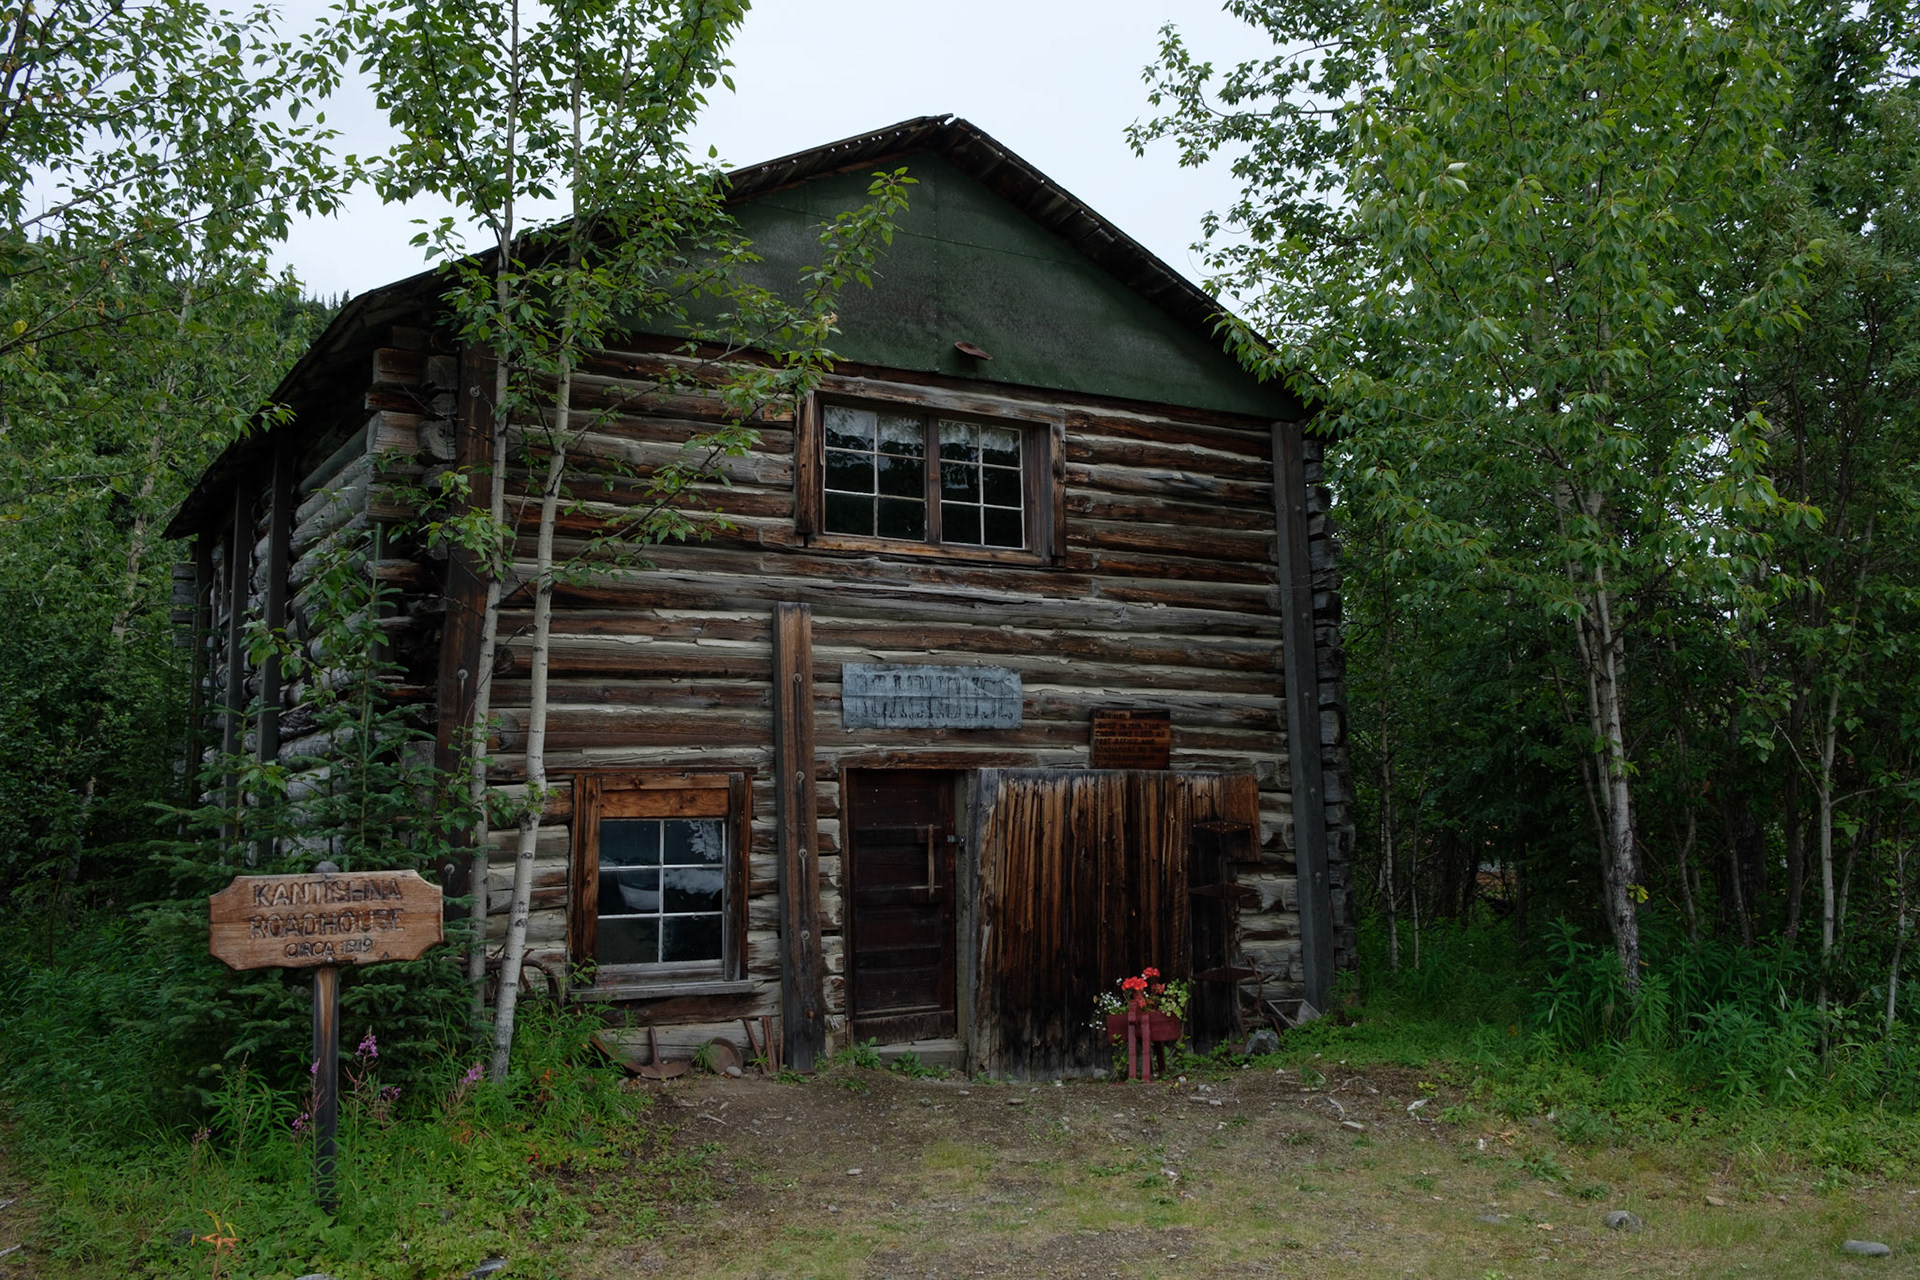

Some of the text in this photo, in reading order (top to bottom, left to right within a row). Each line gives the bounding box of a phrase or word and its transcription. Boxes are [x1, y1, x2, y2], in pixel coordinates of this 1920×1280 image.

[253, 878, 403, 908] KANTISHNA
[249, 907, 405, 939] ROADHOUSE
[285, 940, 335, 959] CIRCA
